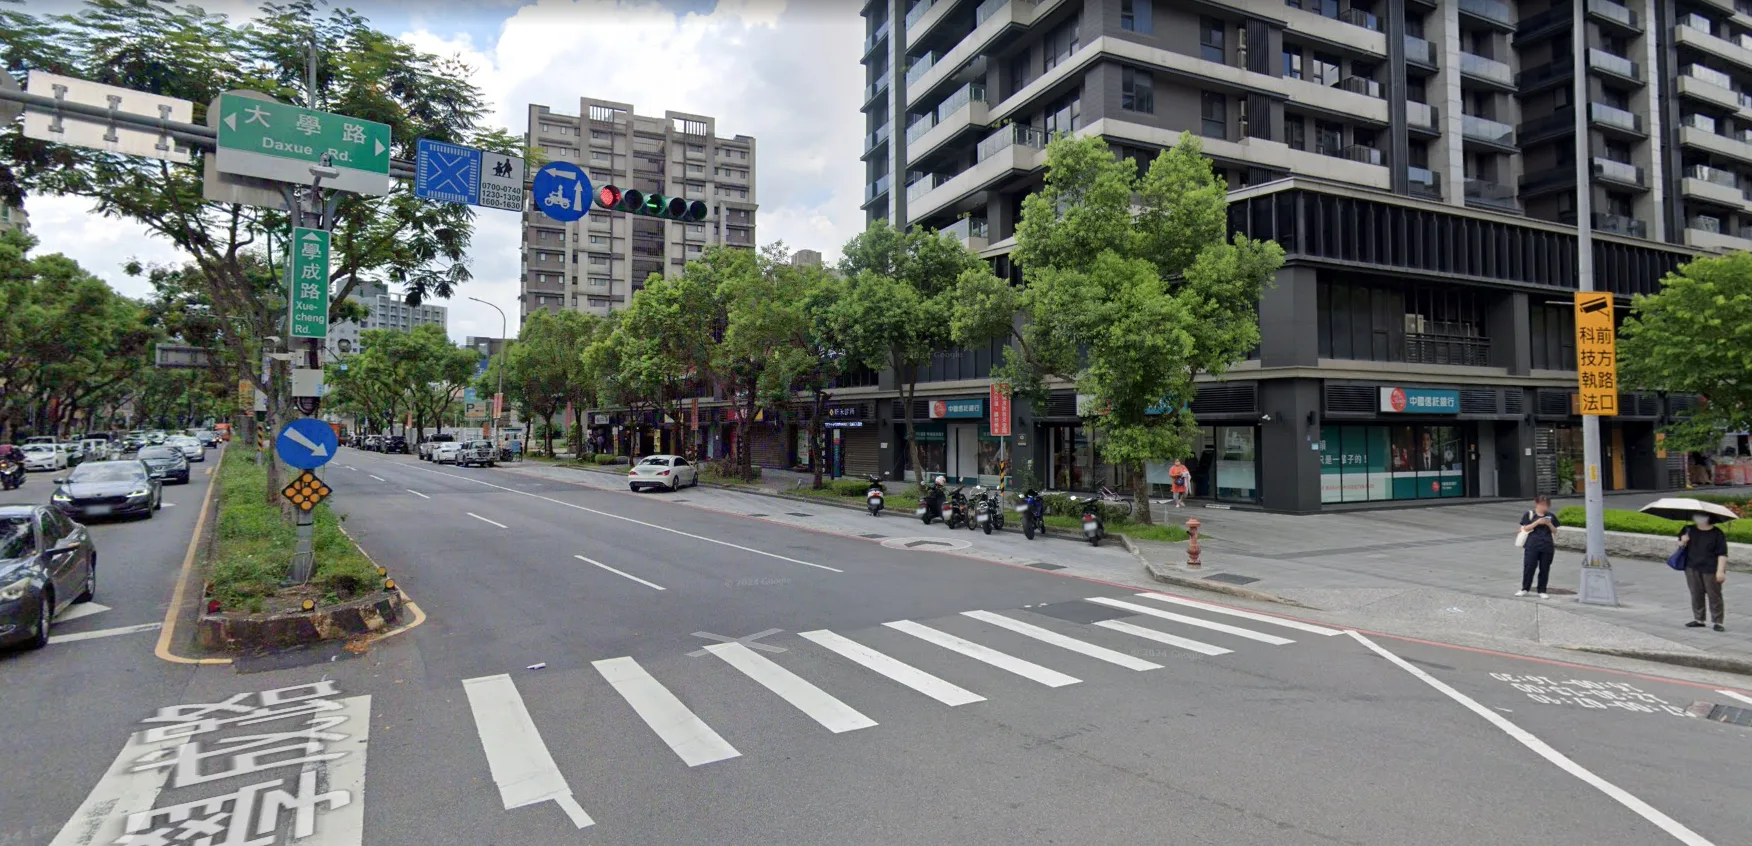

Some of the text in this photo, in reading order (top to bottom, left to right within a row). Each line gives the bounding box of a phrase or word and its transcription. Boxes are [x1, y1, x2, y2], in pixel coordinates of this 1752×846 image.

[244, 104, 367, 145] 大學路
[262, 136, 353, 162] Daxue Rd.
[481, 182, 522, 195] 0700-0740
[481, 190, 522, 202] 1230-1300
[481, 198, 521, 210] 1600-1630
[301, 242, 322, 300] 學成路
[295, 301, 318, 311] Xue-
[295, 312, 325, 324] cheng
[295, 324, 311, 334] Rd.
[1579, 326, 1599, 411] 科技執法
[1595, 327, 1614, 411] 前方路口
[1409, 395, 1455, 408] 中國信託銀行
[466, 403, 475, 413] P
[947, 404, 980, 413] 中國信託銀行
